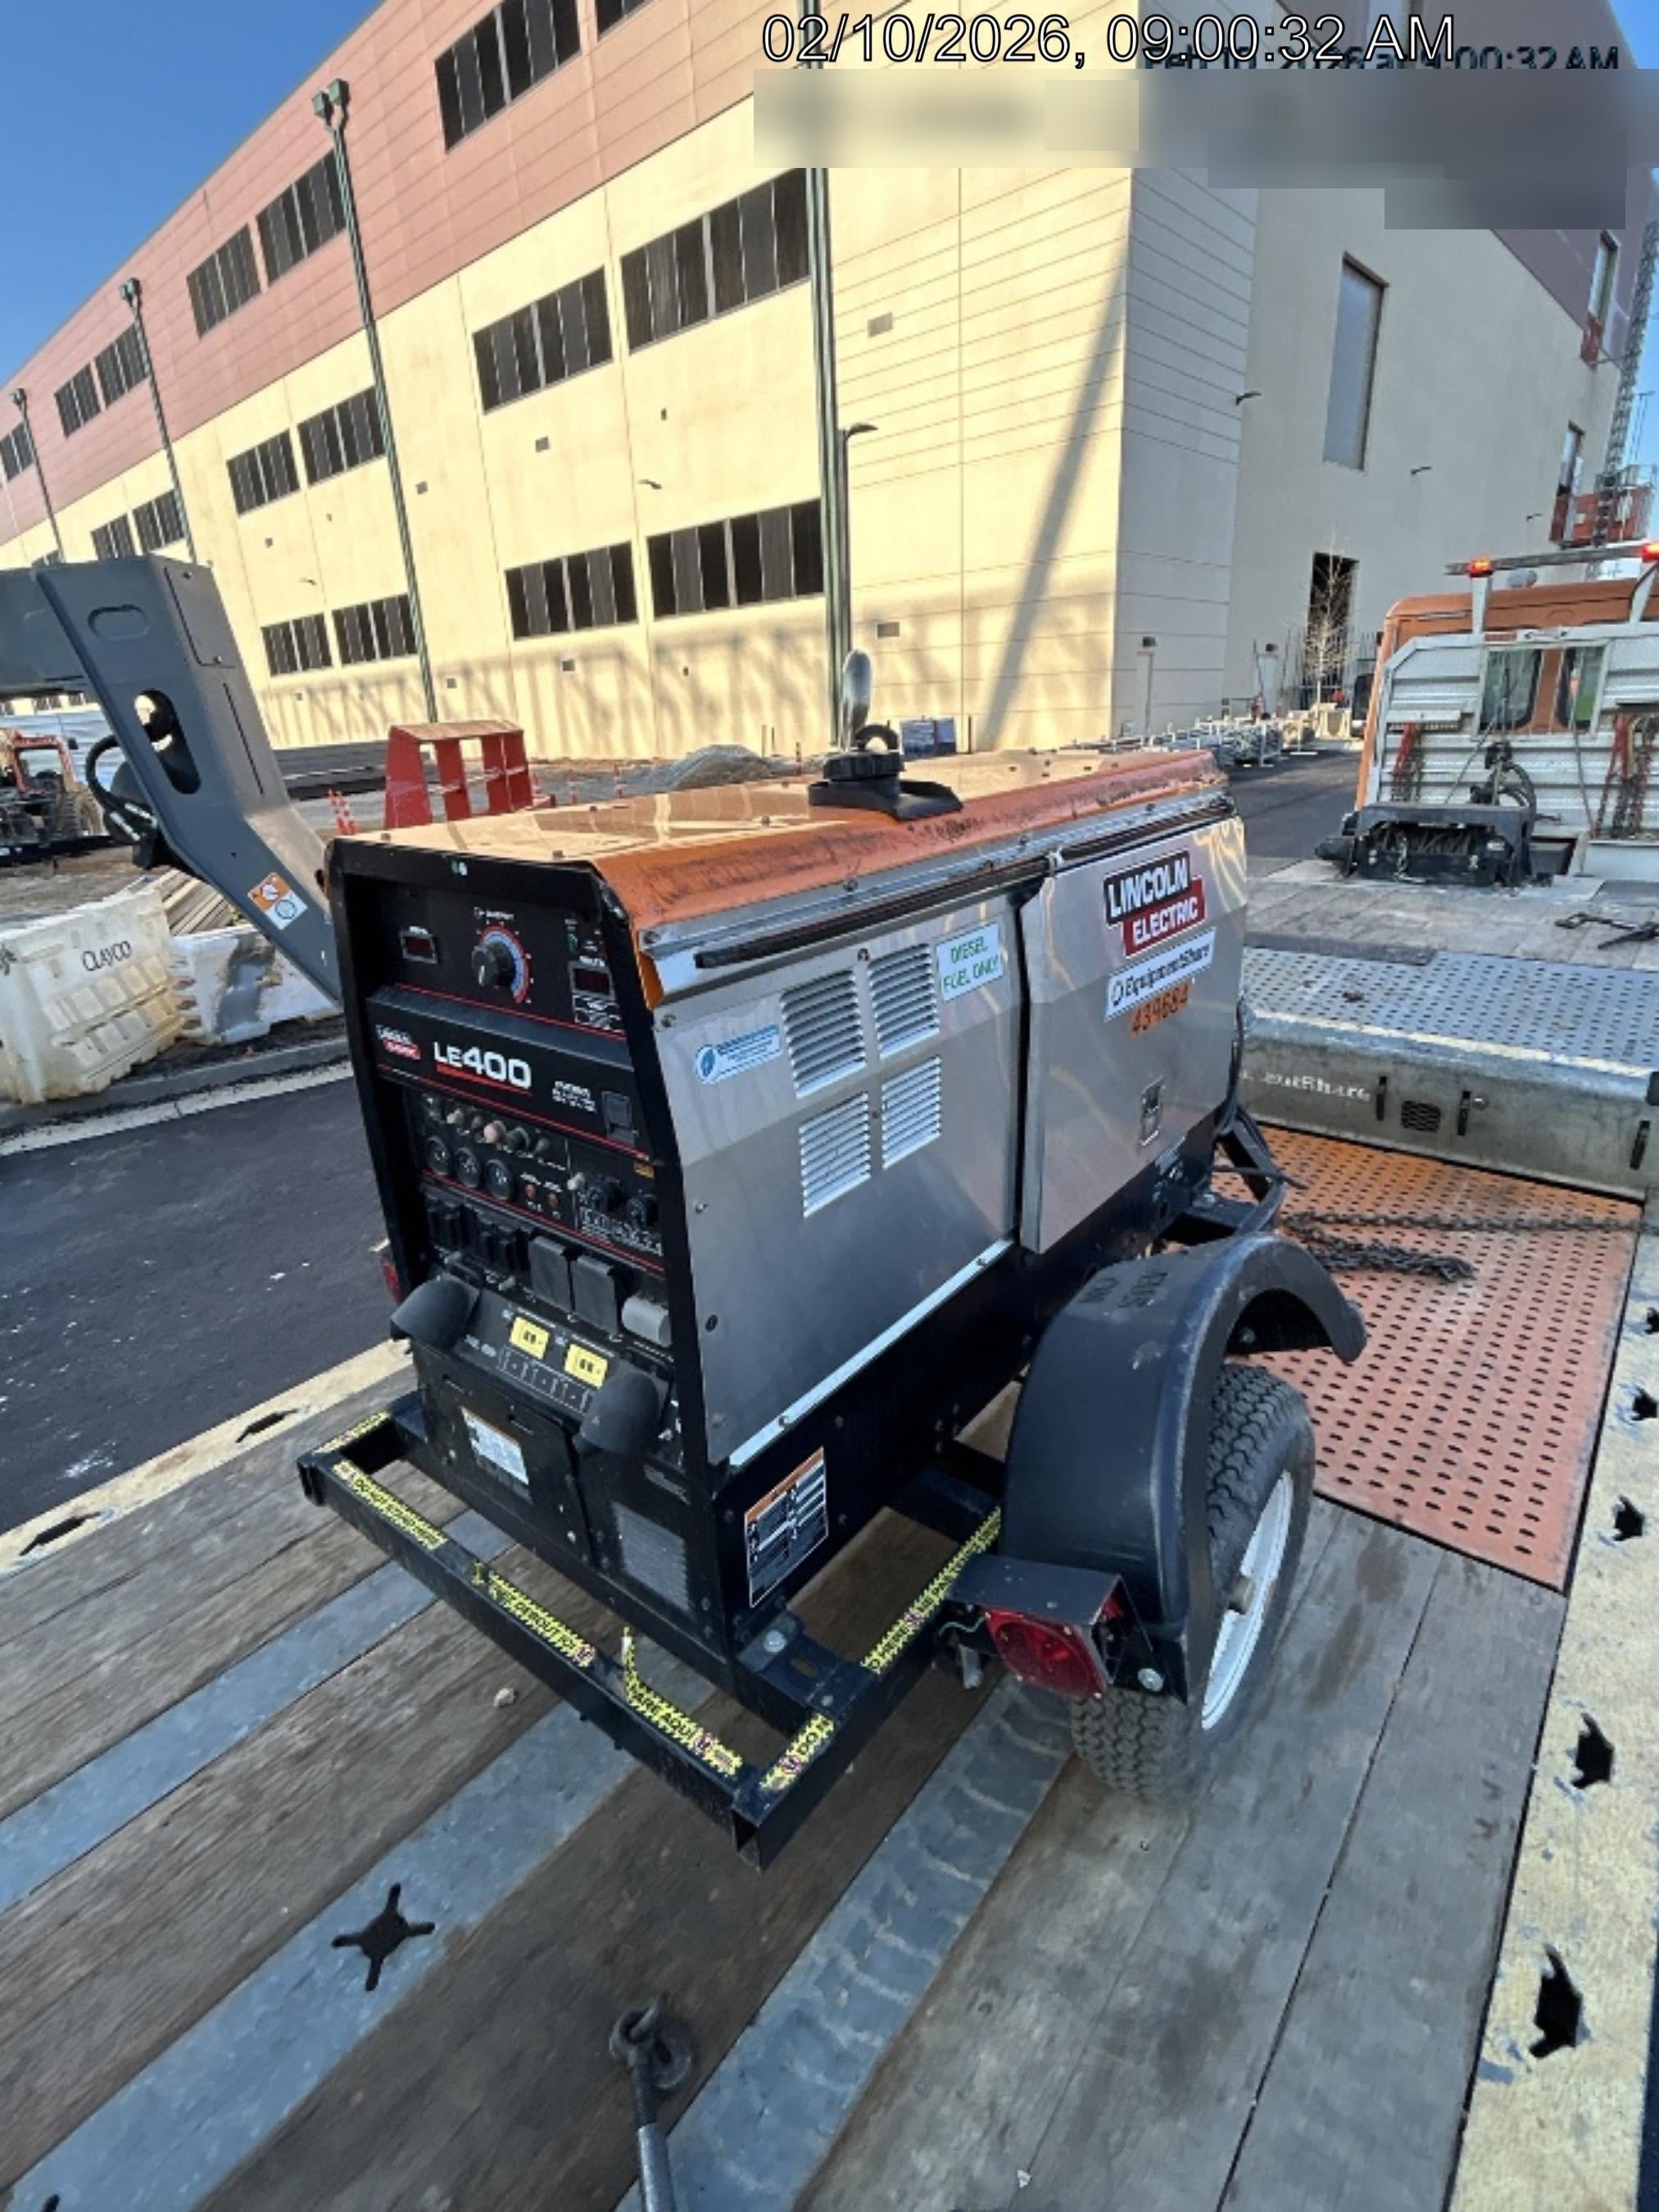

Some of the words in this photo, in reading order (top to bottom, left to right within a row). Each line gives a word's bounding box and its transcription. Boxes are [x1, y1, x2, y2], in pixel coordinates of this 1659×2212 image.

[1108, 857, 1189, 918] LINCOLN
[1132, 896, 1199, 945] ELECTRIC
[943, 968, 972, 993] FUEL
[972, 954, 999, 979] ONLY
[950, 936, 989, 963] DIESEL
[433, 1041, 533, 1090] LE400
